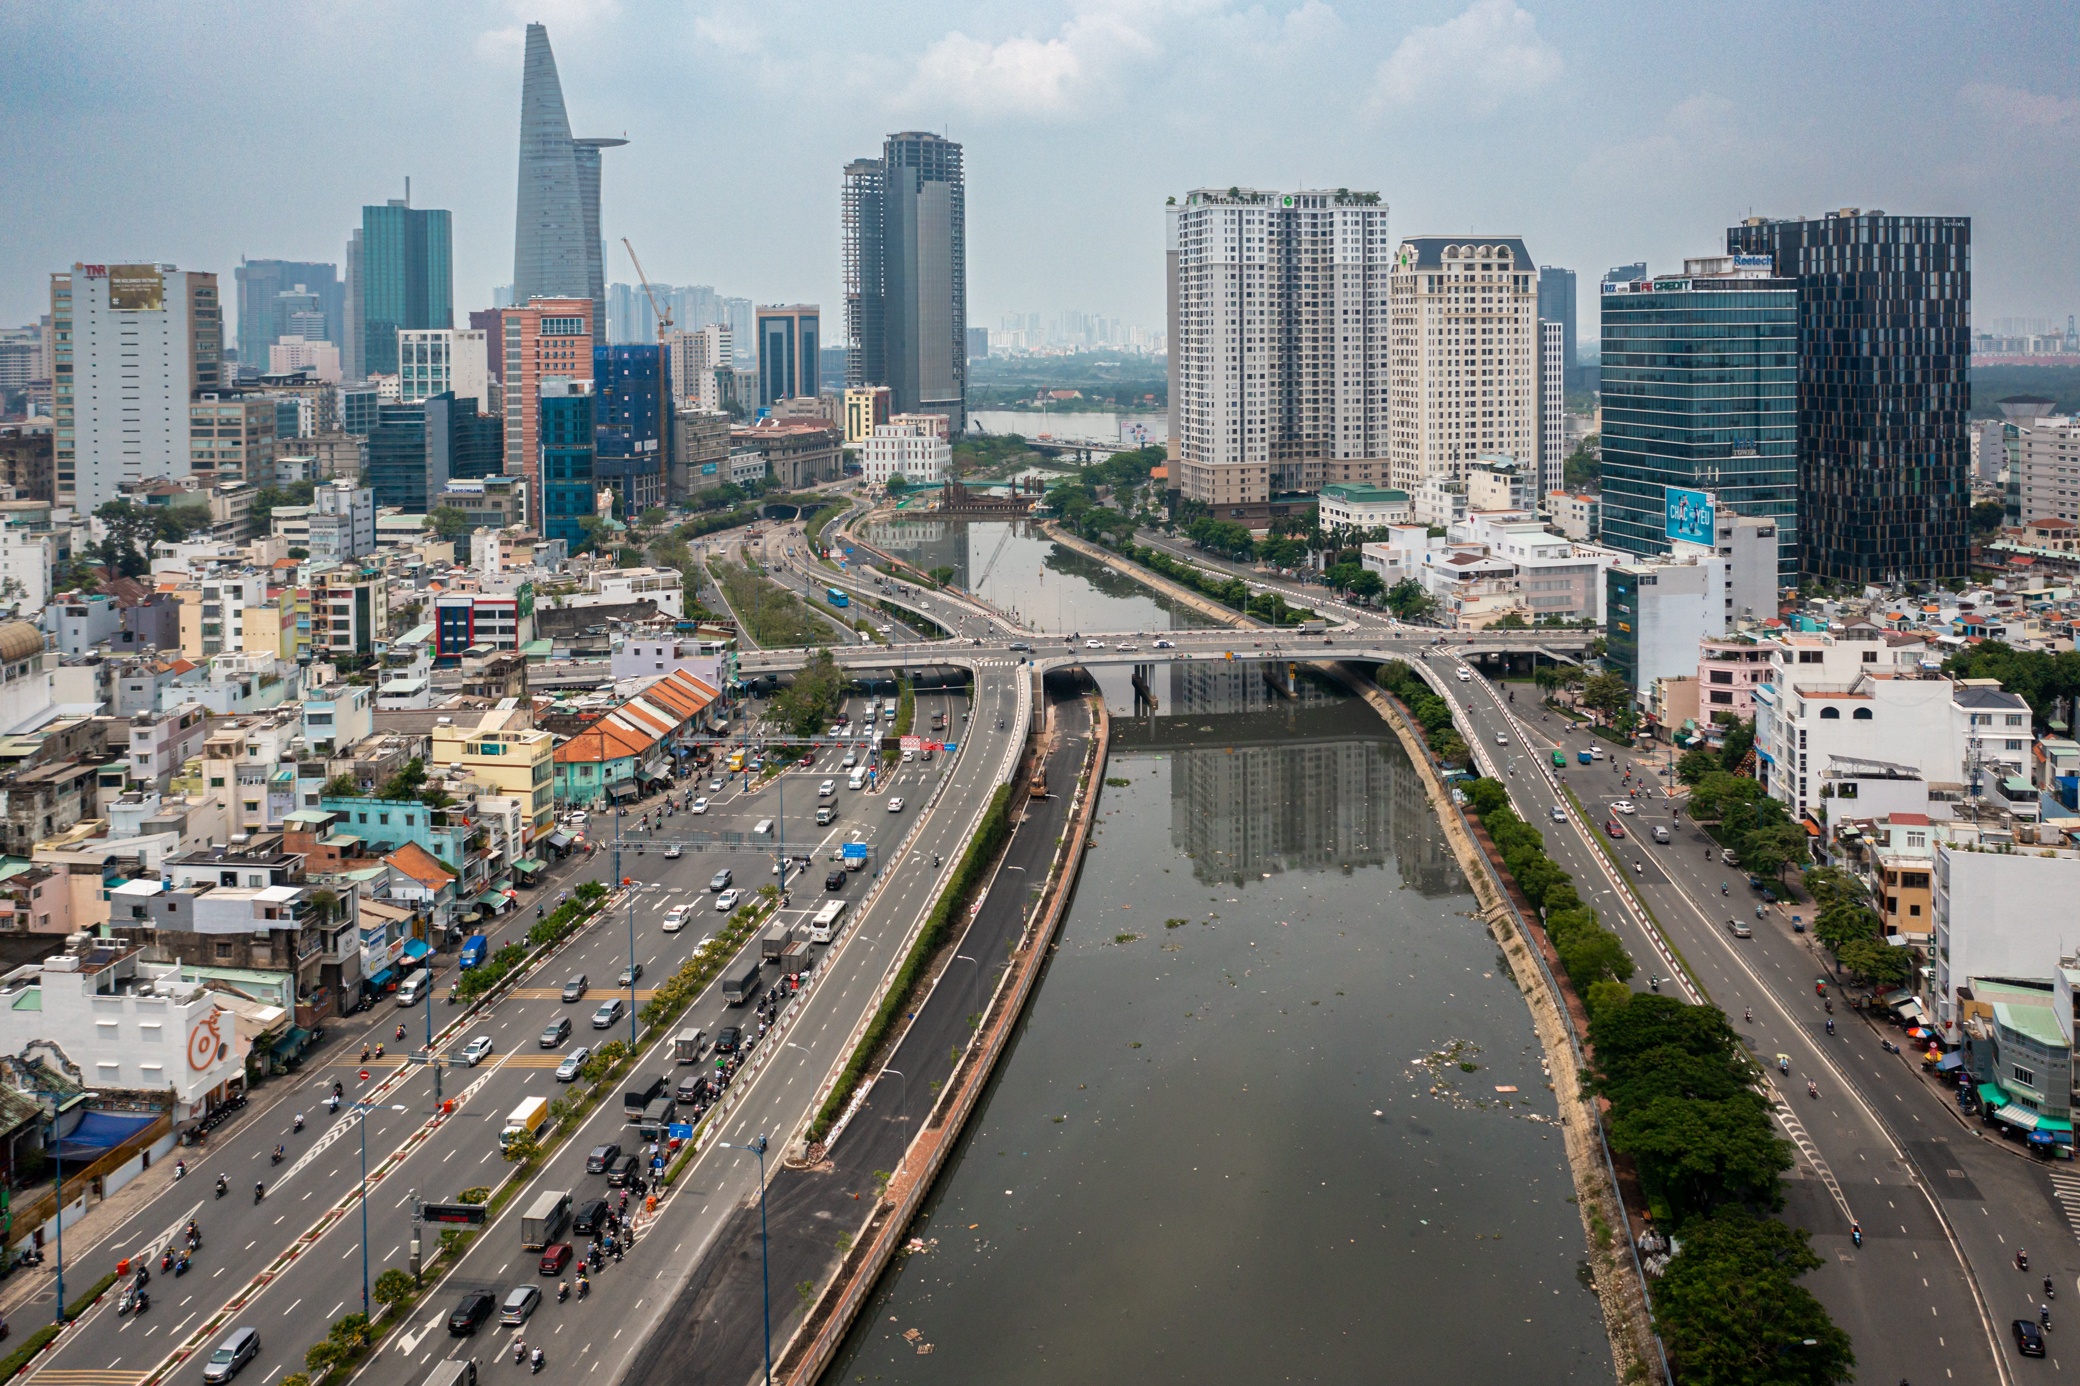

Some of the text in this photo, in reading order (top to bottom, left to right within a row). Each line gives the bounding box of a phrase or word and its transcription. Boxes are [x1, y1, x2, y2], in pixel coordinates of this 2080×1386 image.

[1734, 255, 1772, 266] Reetech
[85, 265, 107, 276] TNR
[1641, 282, 1652, 292] FE
[1653, 281, 1690, 291] CREDIT
[1696, 506, 1710, 526] YÊU
[1927, 933, 1937, 994] HOTEL
